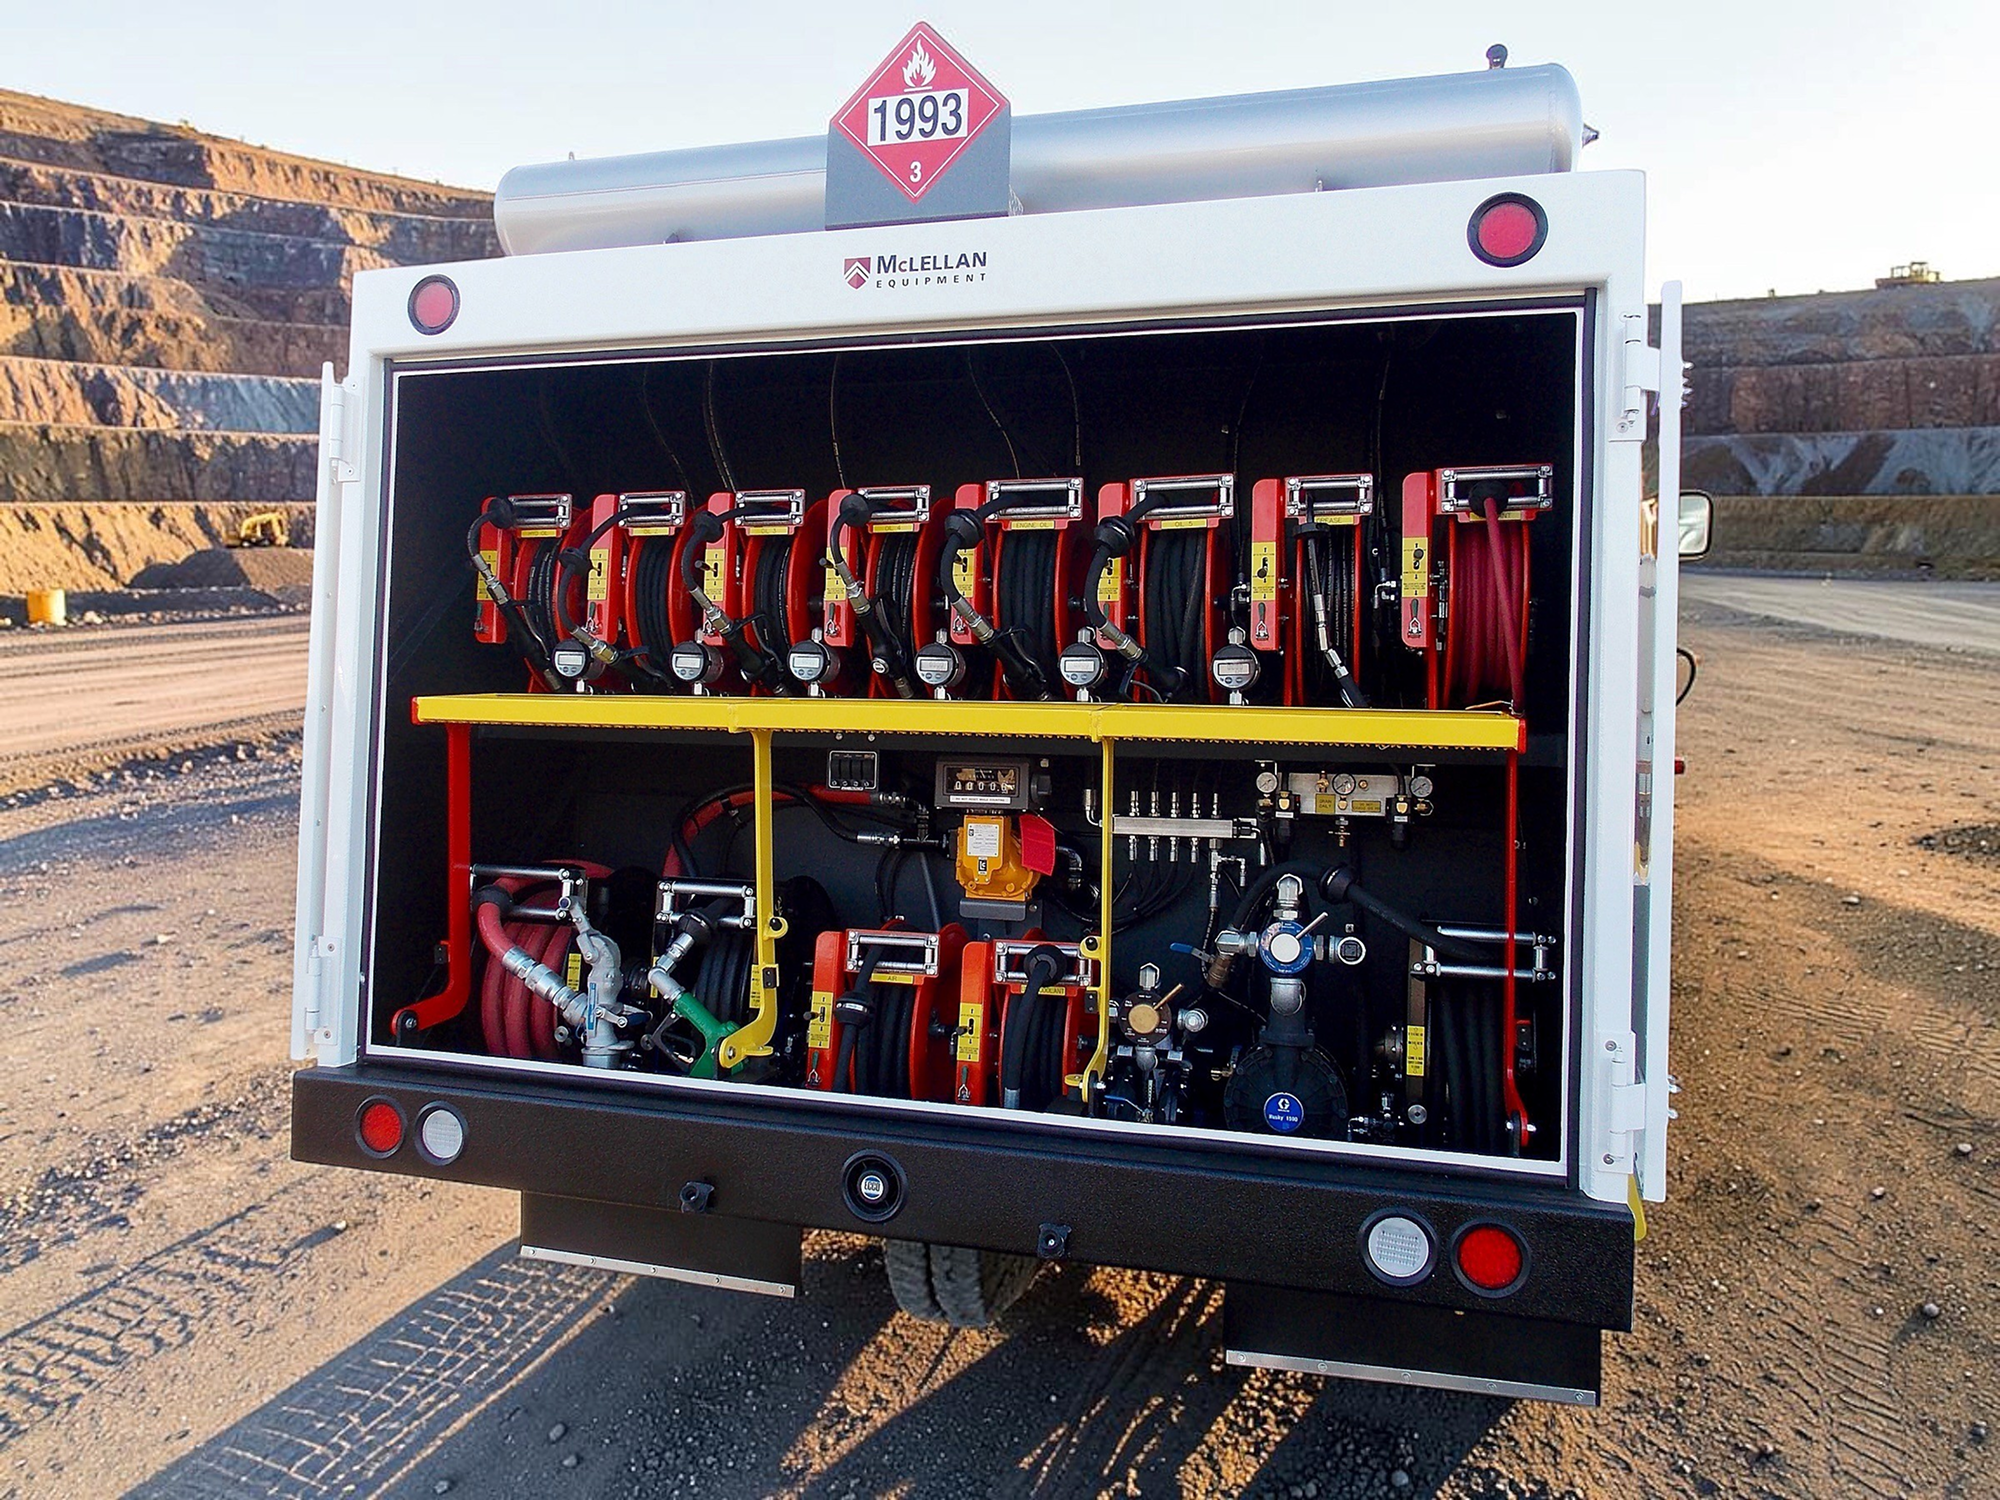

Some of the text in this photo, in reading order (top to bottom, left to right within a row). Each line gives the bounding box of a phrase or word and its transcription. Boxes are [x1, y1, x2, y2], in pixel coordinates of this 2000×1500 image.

[873, 92, 963, 142] 1993
[909, 160, 922, 183] 3
[877, 251, 988, 275] McLELLAN
[876, 272, 987, 289] EQUIPMENT
